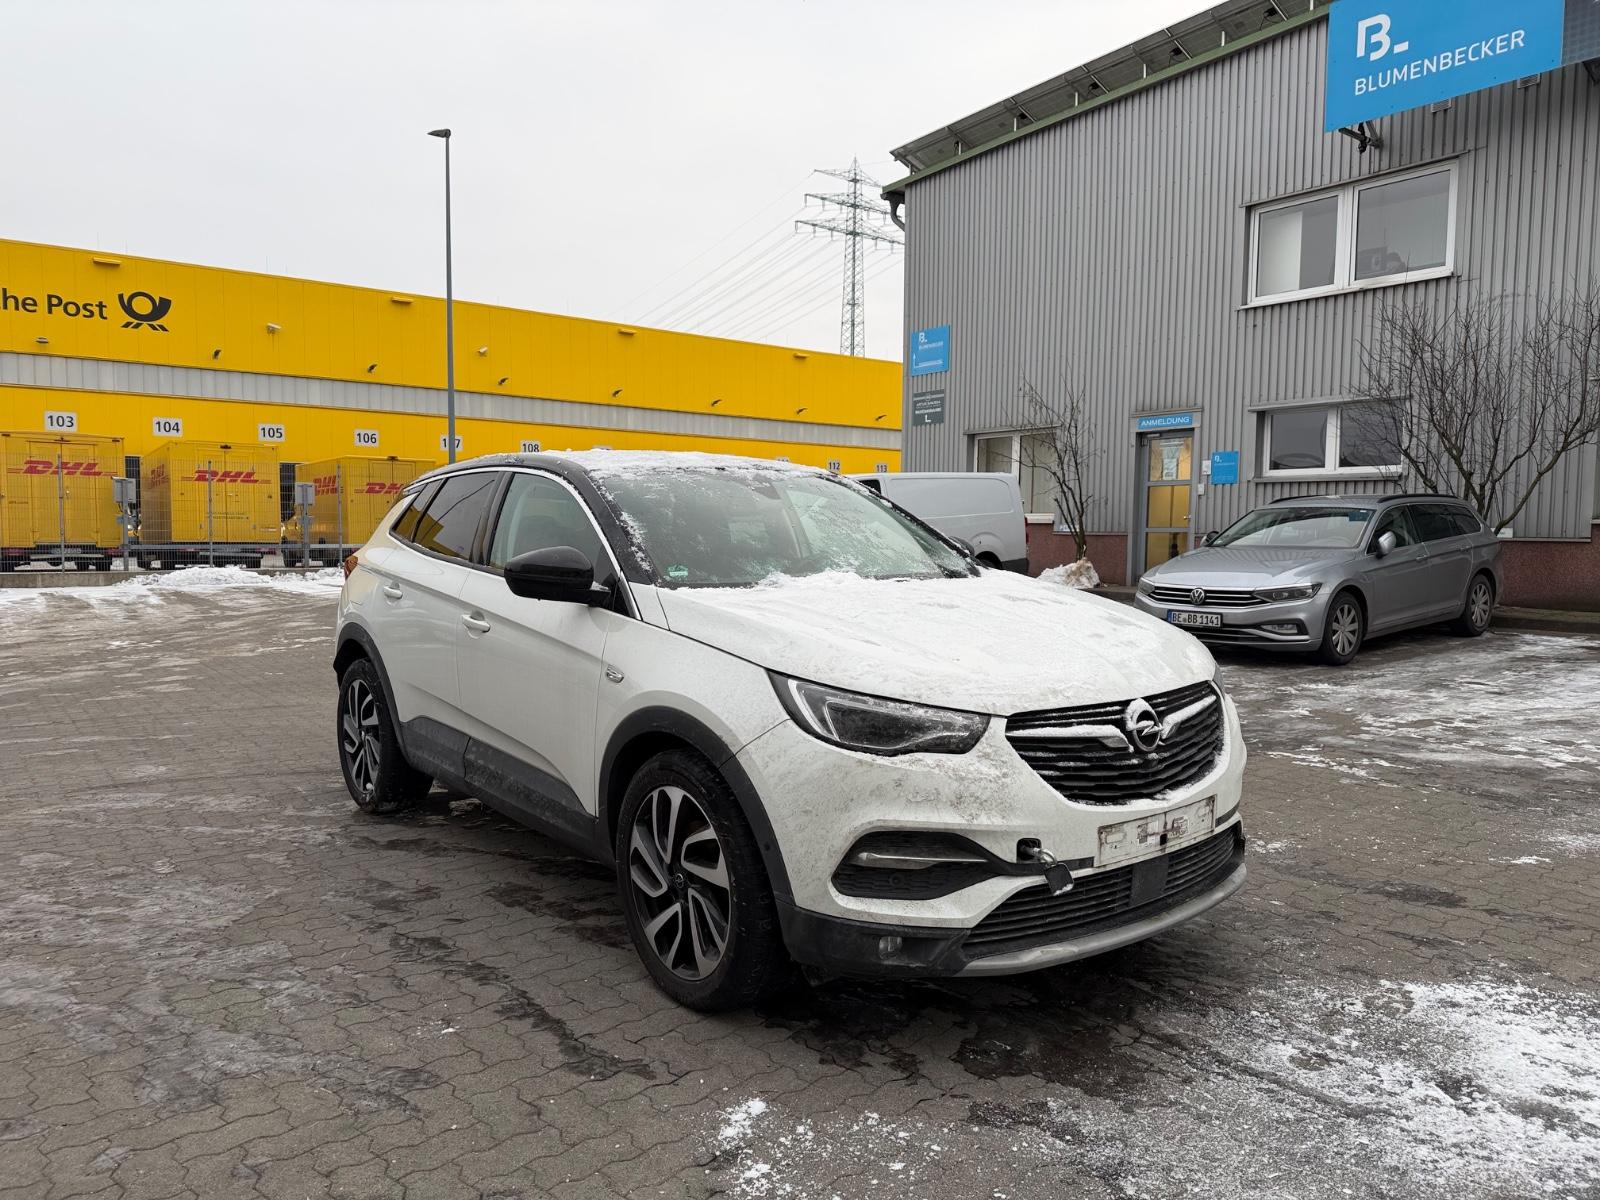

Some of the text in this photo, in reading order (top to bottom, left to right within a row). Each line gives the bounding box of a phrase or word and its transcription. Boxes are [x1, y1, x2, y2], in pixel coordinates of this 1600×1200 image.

[1355, 29, 1525, 96] BLUMENBECKER
[47, 293, 108, 320] Post
[47, 415, 74, 428] 103
[1141, 416, 1190, 426] ANMELDUNG
[155, 421, 180, 434] 104
[260, 427, 283, 439] 105
[356, 432, 377, 444] 106
[443, 438, 461, 449] 17
[522, 443, 540, 452] 108
[22, 459, 103, 476] DHL
[829, 462, 840, 470] 112
[876, 464, 888, 472] 113
[193, 470, 259, 483] DHL
[1172, 612, 1219, 626] BE BB 1141
